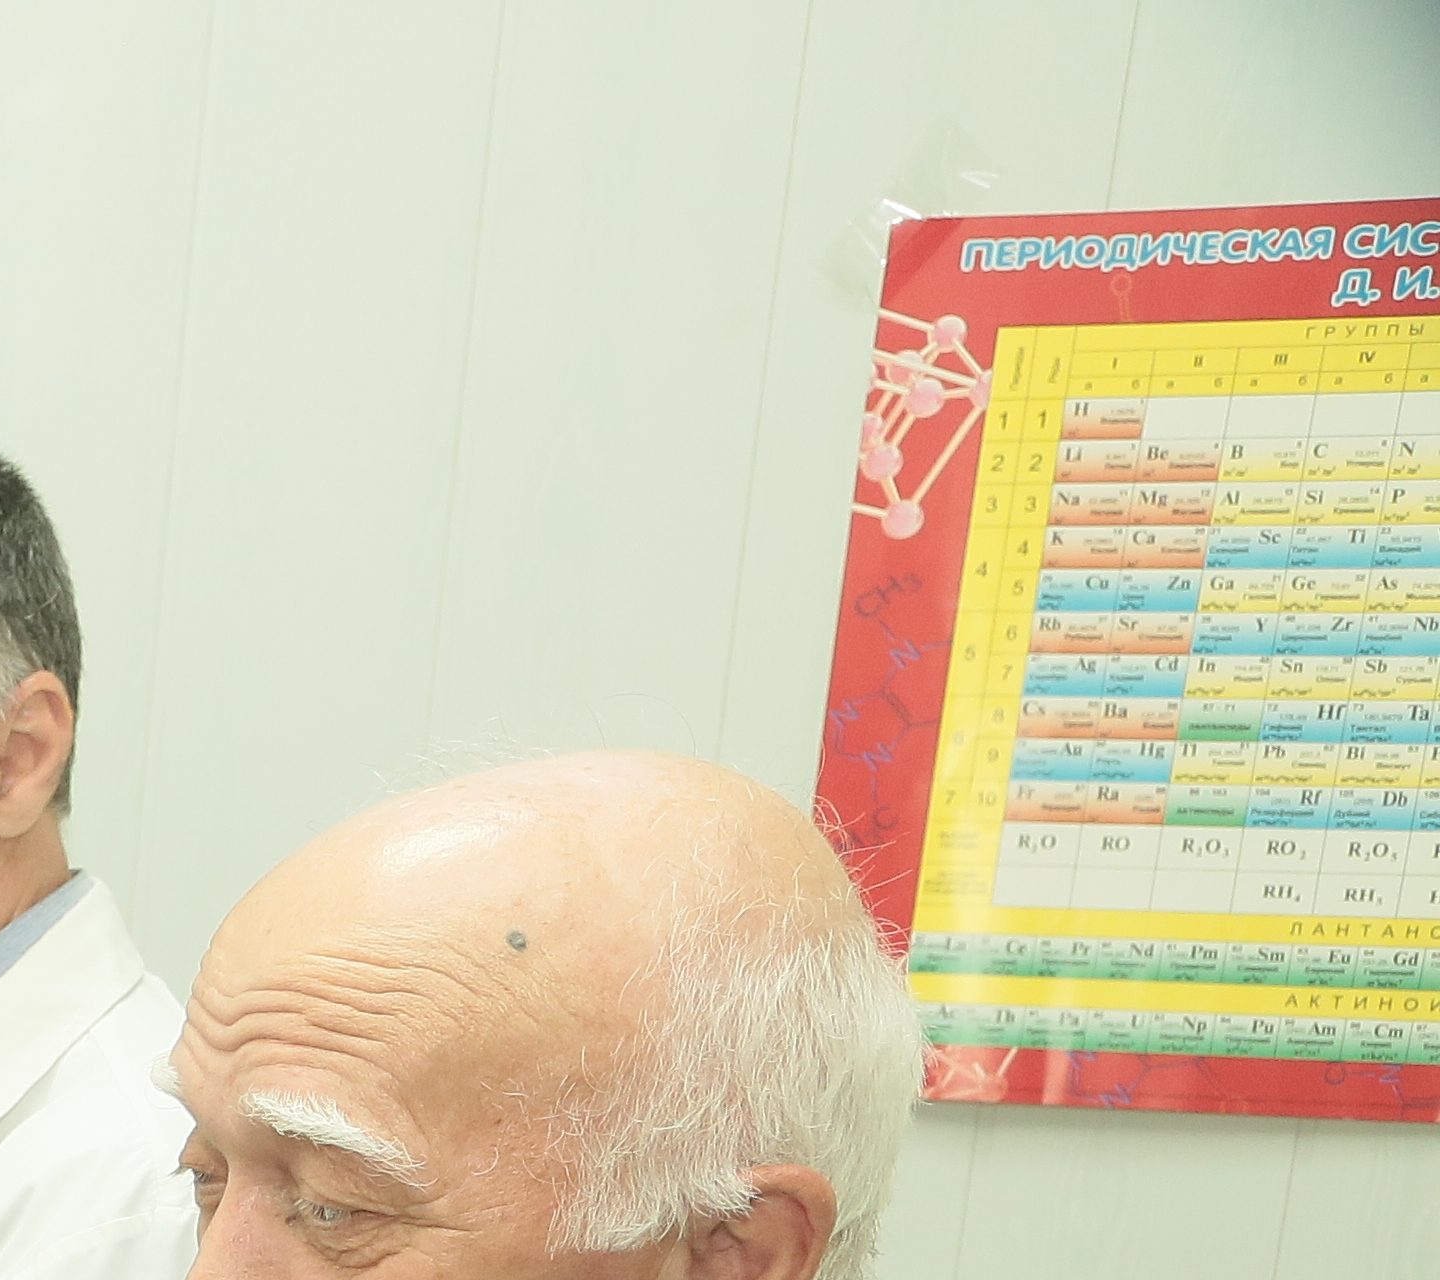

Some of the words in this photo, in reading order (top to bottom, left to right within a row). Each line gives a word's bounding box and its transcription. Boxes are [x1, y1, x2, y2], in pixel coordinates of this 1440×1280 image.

[959, 226, 1335, 273] ПЕРИОДИЧЕСКАЯ
[1331, 268, 1381, 308] Д.
[1393, 265, 1440, 300] И.
[1305, 323, 1425, 340] ГРУППЫ
[1273, 353, 1289, 366] III
[1358, 351, 1376, 364] IV
[1074, 402, 1090, 417] H
[1065, 446, 1083, 463] Li
[1146, 446, 1169, 461] Be
[1230, 444, 1245, 460] B
[1313, 443, 1330, 459] C
[1397, 441, 1417, 458] N
[990, 454, 1005, 472] 2
[1029, 454, 1043, 472] 2
[1054, 491, 1080, 506] Na
[1138, 490, 1169, 508] Mg
[1220, 490, 1240, 506] Al
[1304, 489, 1324, 505] Si
[1390, 488, 1406, 504] P
[985, 495, 998, 514] 3
[1024, 495, 1037, 513] 3
[1051, 531, 1064, 545] K
[1132, 530, 1156, 545] Ca
[1258, 530, 1282, 545] Sc
[1347, 528, 1367, 544] Ti
[1017, 539, 1028, 556] 4
[1085, 576, 1109, 590] Cu
[1167, 577, 1191, 591] Zn
[1210, 576, 1234, 590] Ga
[1292, 575, 1316, 591] Ge
[1375, 575, 1398, 590] As
[1038, 618, 1061, 631] Rb
[1118, 617, 1138, 631] Sr
[1254, 618, 1268, 632] Y
[1331, 617, 1354, 631] Zr
[1413, 616, 1439, 631] Nb
[1075, 658, 1097, 673] Ag
[1155, 656, 1178, 671] Cd
[1198, 660, 1216, 672] In
[1280, 660, 1304, 673] Sn
[1364, 659, 1388, 674] Sb
[1022, 702, 1046, 716] Cs
[1104, 703, 1128, 718] Ba
[1316, 704, 1347, 721] Hf
[1408, 704, 1430, 721] Ta
[1061, 743, 1083, 756] Au
[1140, 743, 1166, 759] Hg
[1263, 745, 1286, 759] Pb
[1346, 746, 1365, 760] Bi
[1097, 786, 1119, 801] Ra
[1301, 791, 1322, 806] Rf
[1382, 792, 1408, 807] Db
[1101, 836, 1131, 851] RO
[1131, 942, 1155, 957] Nd
[1190, 945, 1219, 960] Pm
[1257, 947, 1285, 963] Sm
[1328, 950, 1352, 965] Eu
[1393, 951, 1420, 967] Gd
[1182, 1016, 1207, 1034] Np
[1252, 1020, 1275, 1034] Pu
[1308, 1022, 1337, 1036] Am
[1373, 1024, 1404, 1038] Cm
